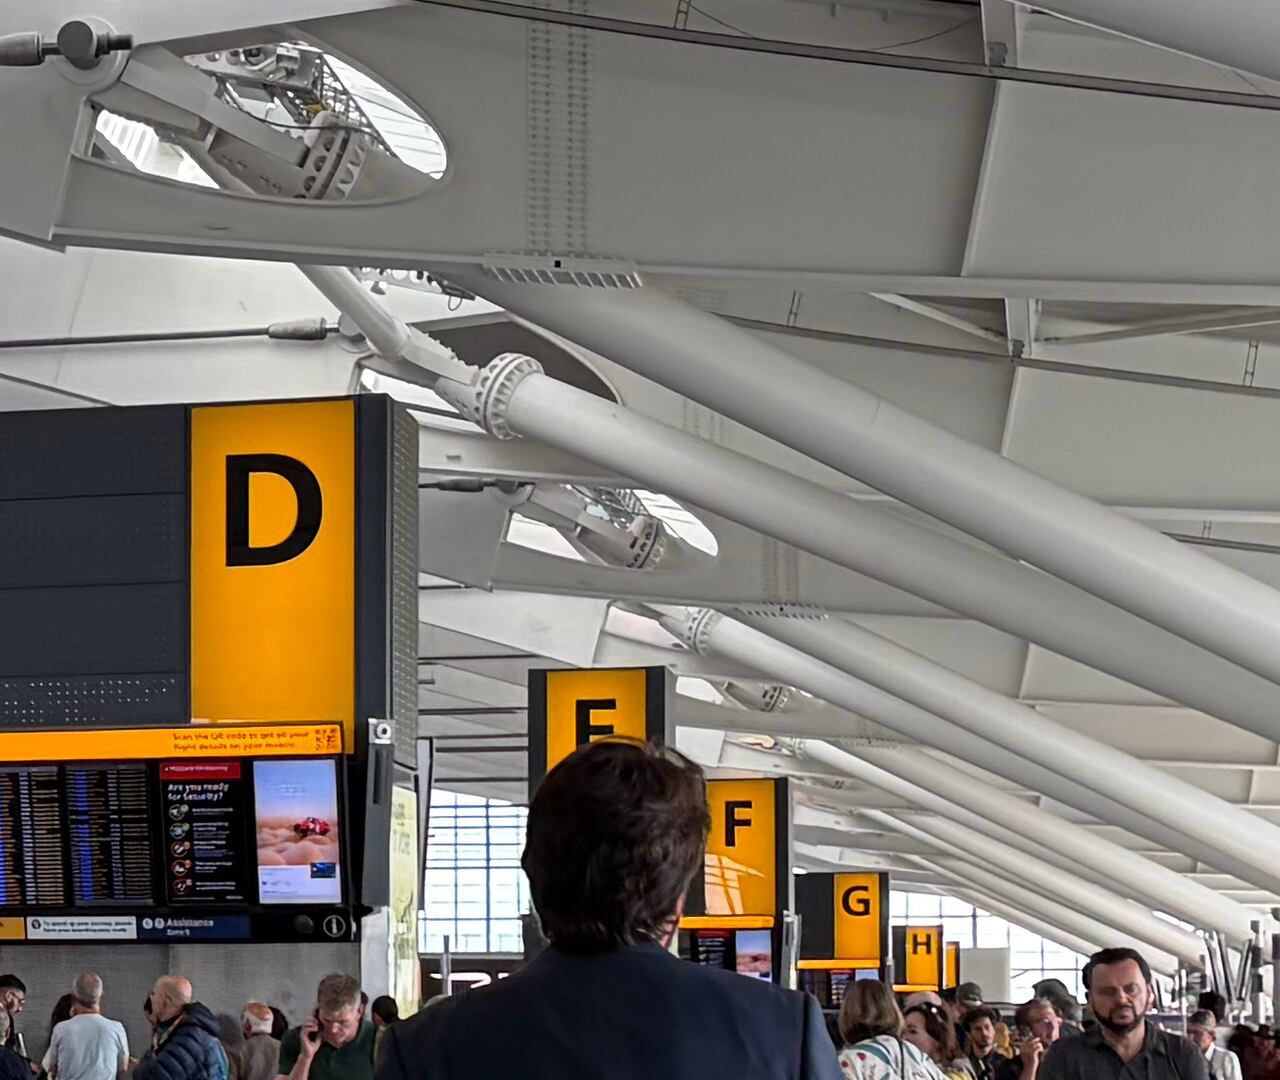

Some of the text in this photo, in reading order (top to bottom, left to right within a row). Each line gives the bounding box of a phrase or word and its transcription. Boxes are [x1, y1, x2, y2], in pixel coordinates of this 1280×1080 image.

[225, 453, 323, 568] D
[724, 800, 753, 848] F
[841, 885, 871, 917] G
[166, 917, 215, 927] Assistance
[912, 933, 932, 955] H
